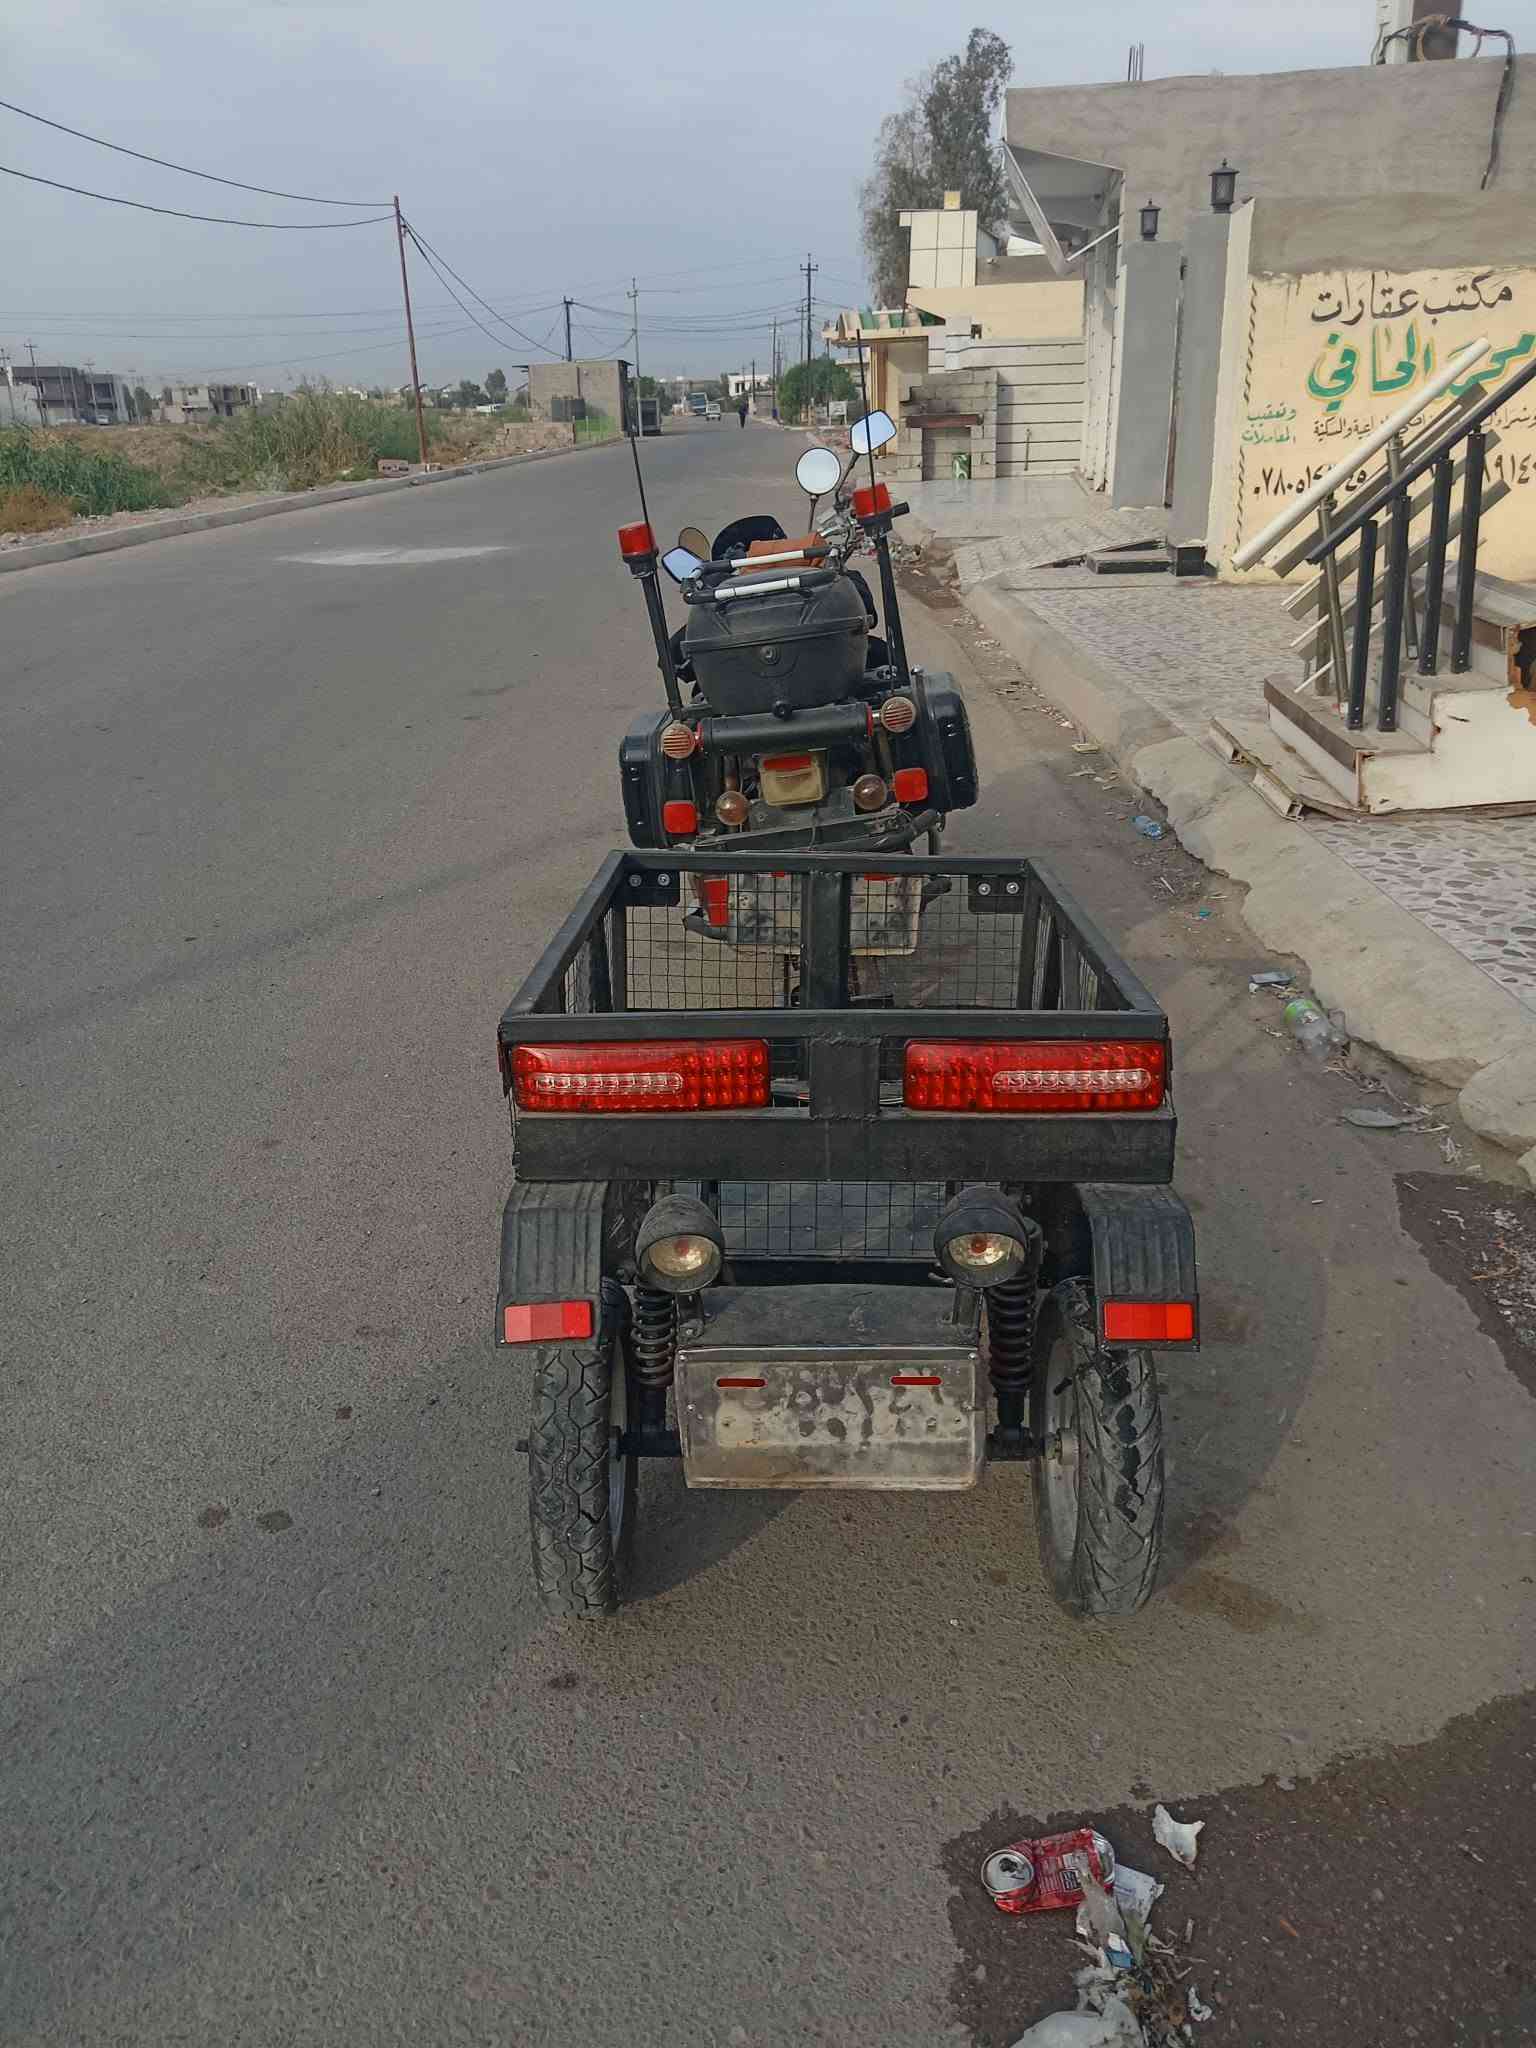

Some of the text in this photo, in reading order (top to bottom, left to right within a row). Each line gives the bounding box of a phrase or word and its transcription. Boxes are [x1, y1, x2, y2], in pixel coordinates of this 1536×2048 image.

[1311, 271, 1513, 325] مكتب عقارات
[1247, 401, 1297, 427] وتعقيب
